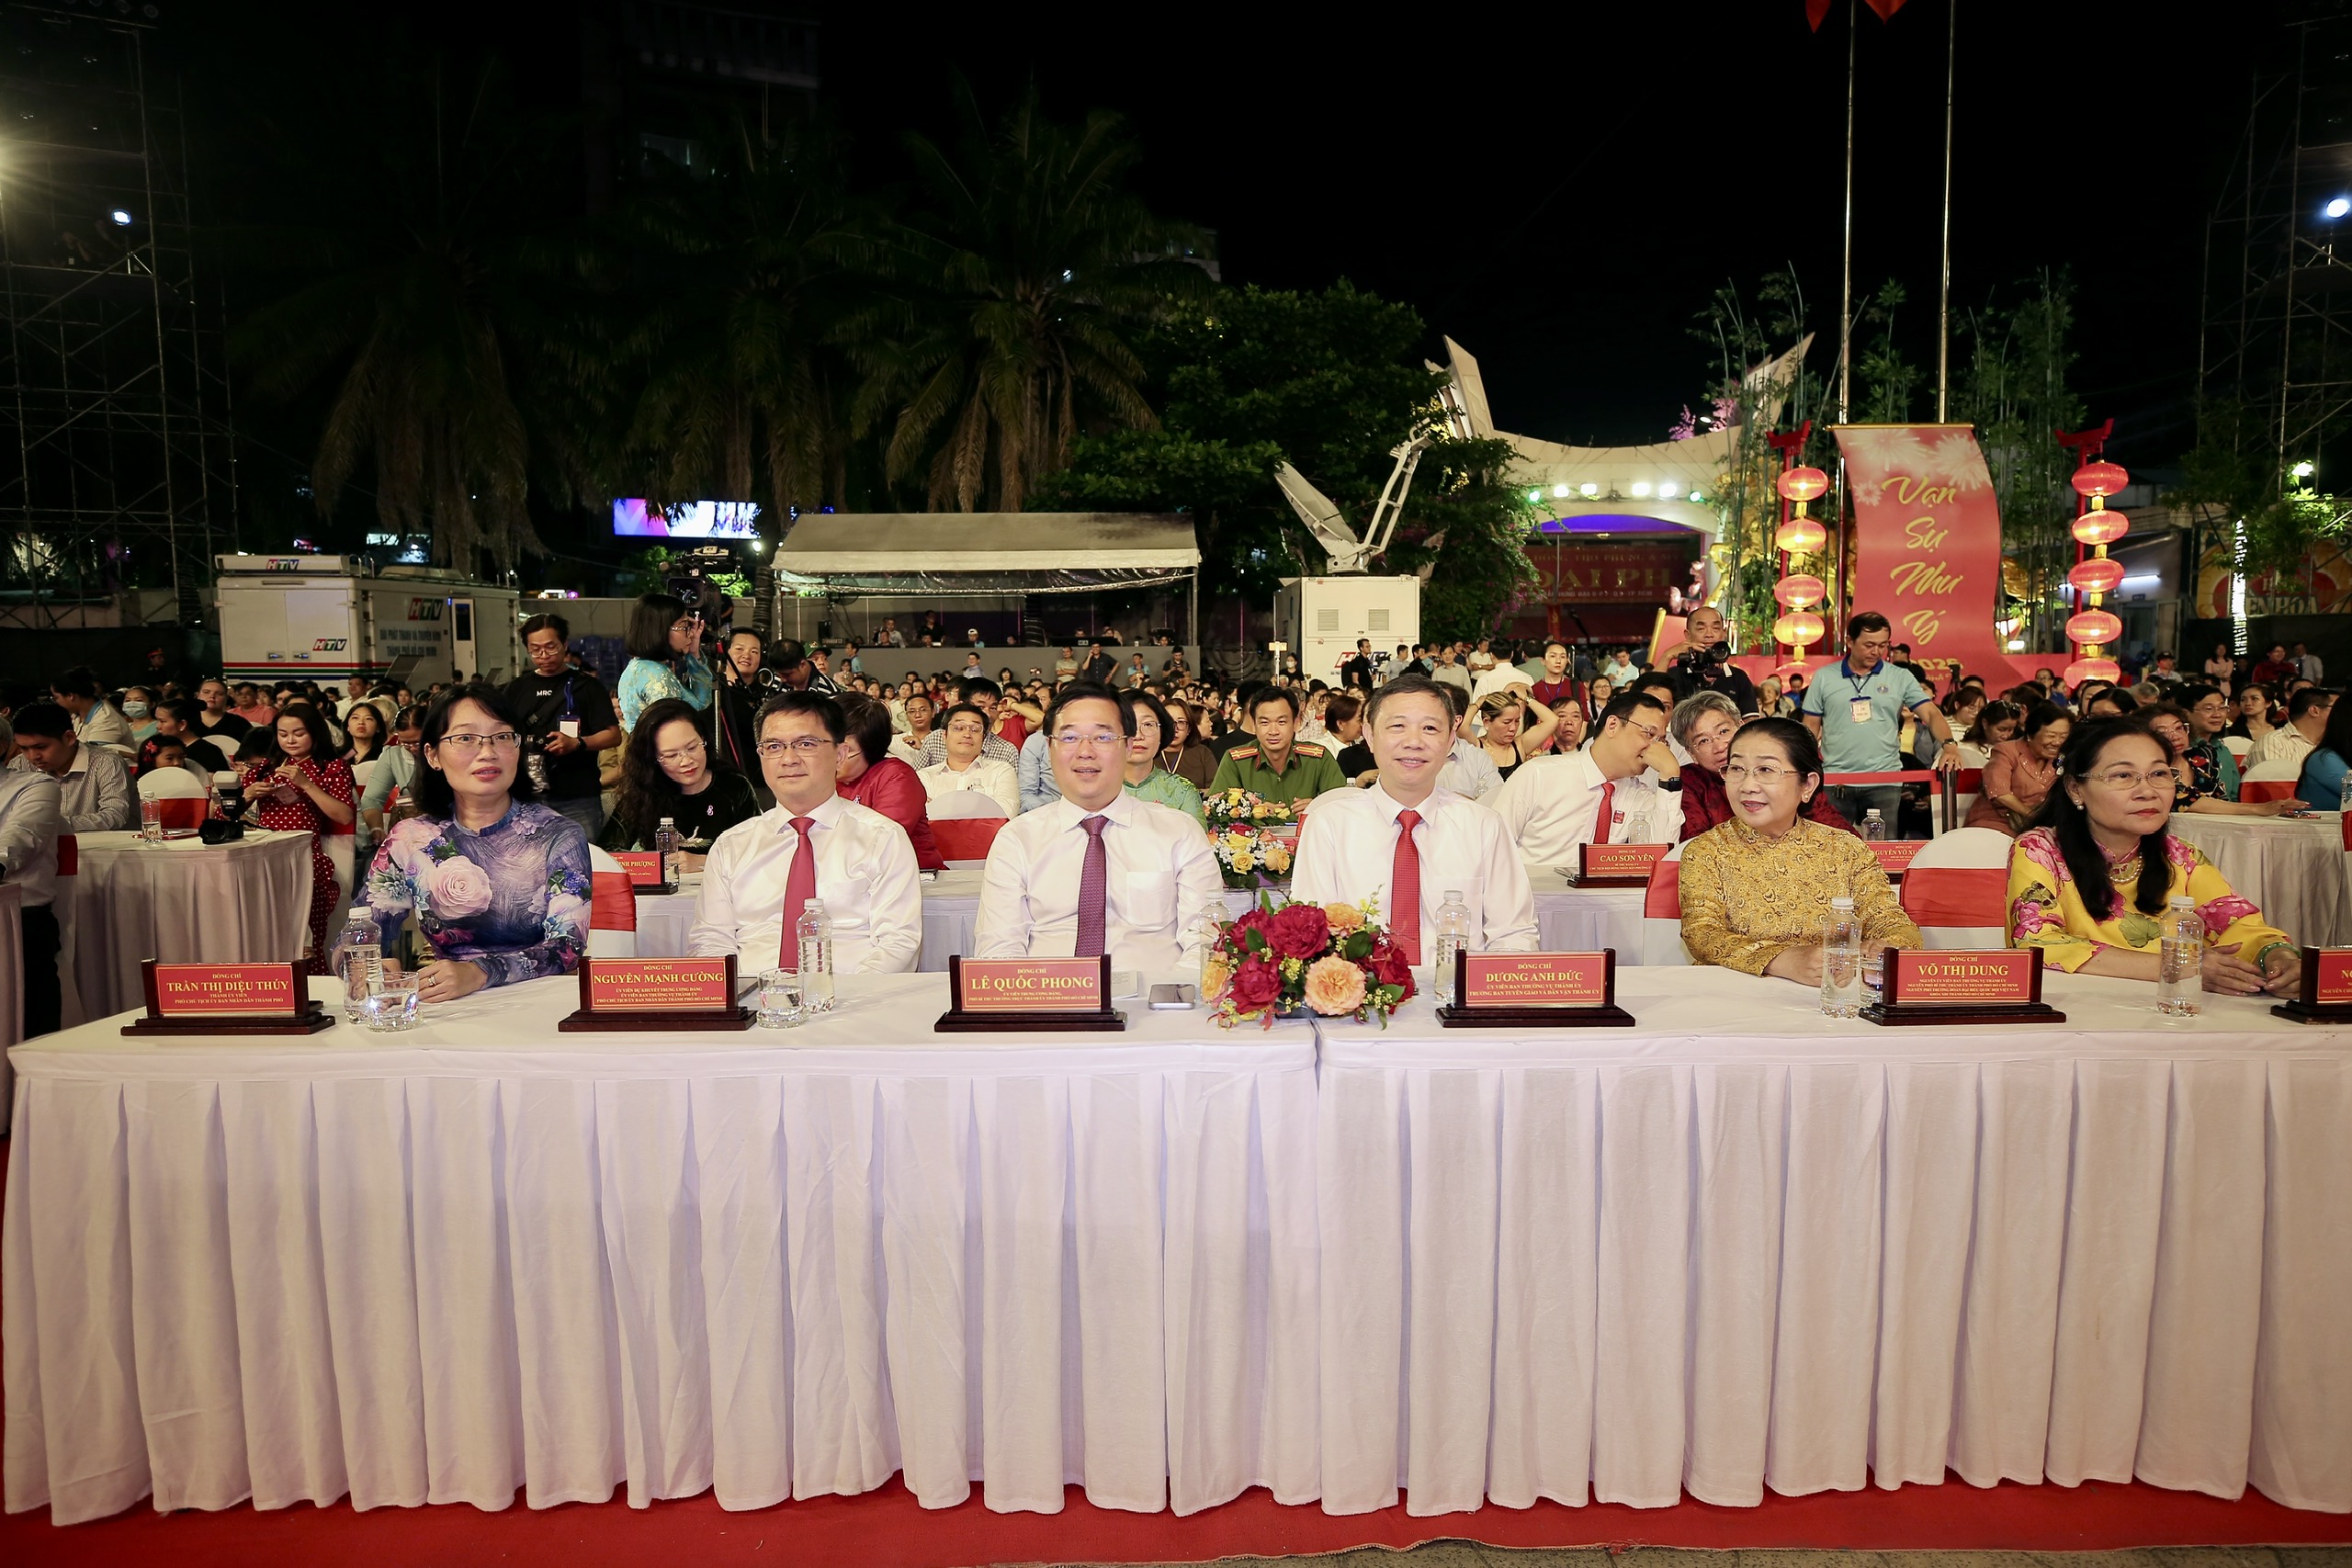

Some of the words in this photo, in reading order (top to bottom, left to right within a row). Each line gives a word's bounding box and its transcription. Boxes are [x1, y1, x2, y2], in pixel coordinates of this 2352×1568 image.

[1882, 476, 1956, 508] Vạn
[1905, 515, 1949, 553] Sự
[266, 559, 300, 570] HTV
[1890, 560, 1963, 596] Như
[408, 598, 444, 620] HTV
[1903, 609, 1946, 646] Ý
[312, 638, 347, 651] HTV
[1637, 853, 1655, 862] YÊN
[594, 973, 641, 984] NGUYỄN
[644, 974, 678, 985] MẠNH
[682, 971, 724, 982] CƯỜNG
[1486, 972, 1529, 982] DƯƠNG
[1531, 972, 1555, 981] ANH
[1558, 970, 1583, 981] ĐỨC
[1918, 963, 1939, 976] VÕ
[1941, 965, 1965, 978] THỊ
[1969, 965, 2008, 976] DUNG
[201, 982, 222, 993] THỊ
[225, 980, 253, 993] DIỆU
[255, 978, 288, 990] THÚY
[971, 975, 990, 989] LÊ
[994, 975, 1037, 992] QUỐC
[1041, 977, 1093, 988] PHONG
